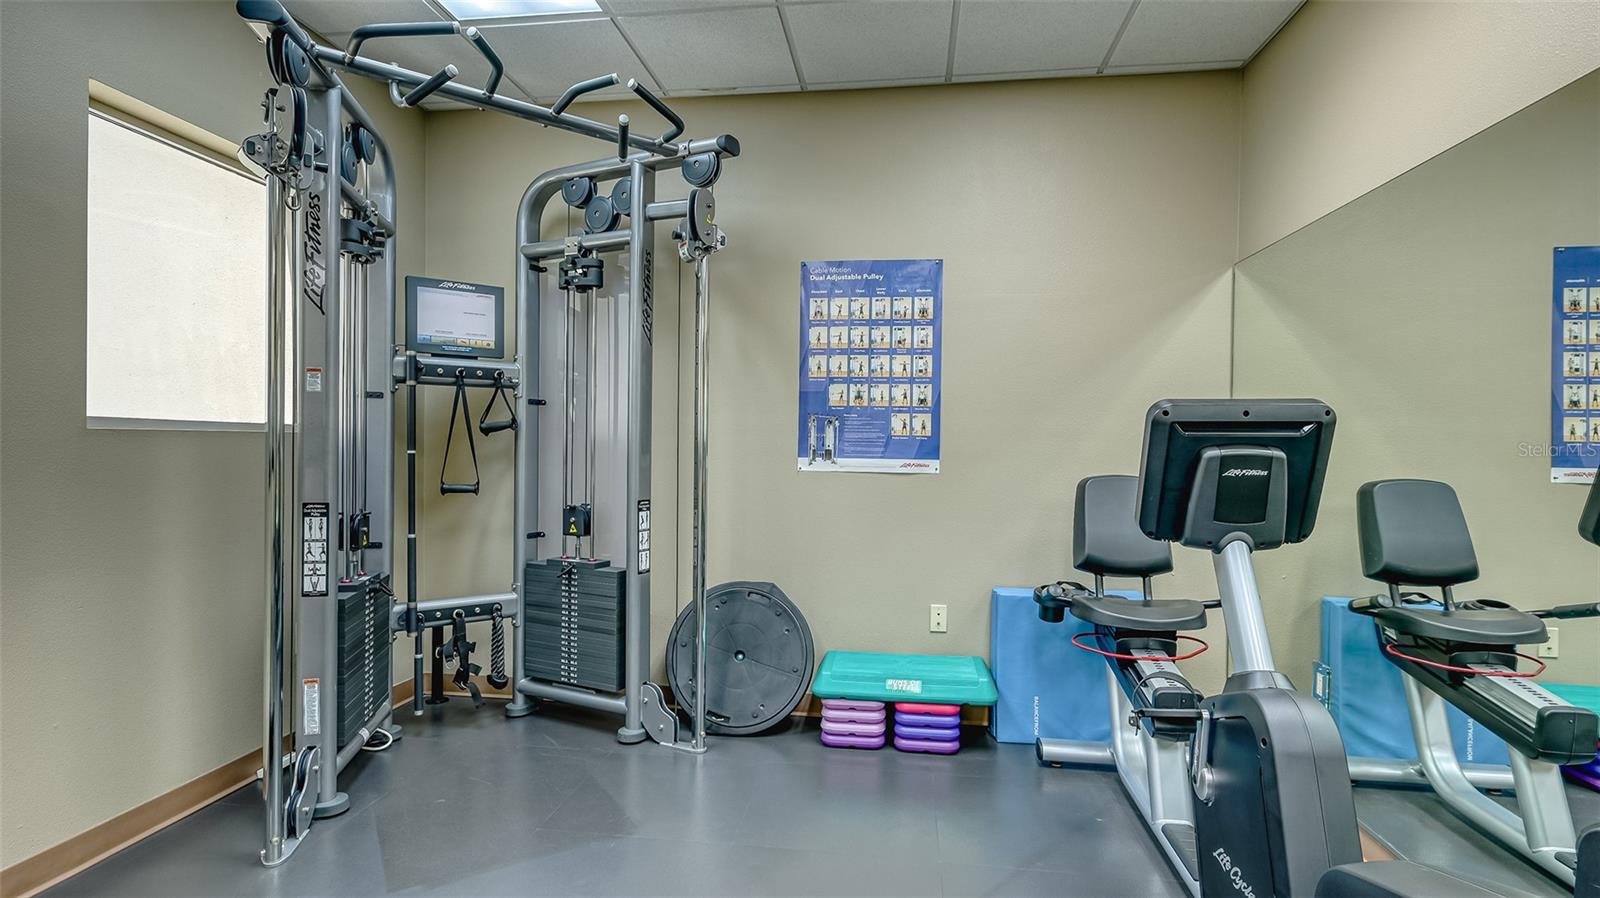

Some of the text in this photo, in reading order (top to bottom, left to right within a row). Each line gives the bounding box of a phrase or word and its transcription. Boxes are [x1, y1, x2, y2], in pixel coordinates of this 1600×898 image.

[303, 191, 327, 316] Life Fitness
[1222, 468, 1269, 477] Life Fitness
[1213, 848, 1232, 871] Life
